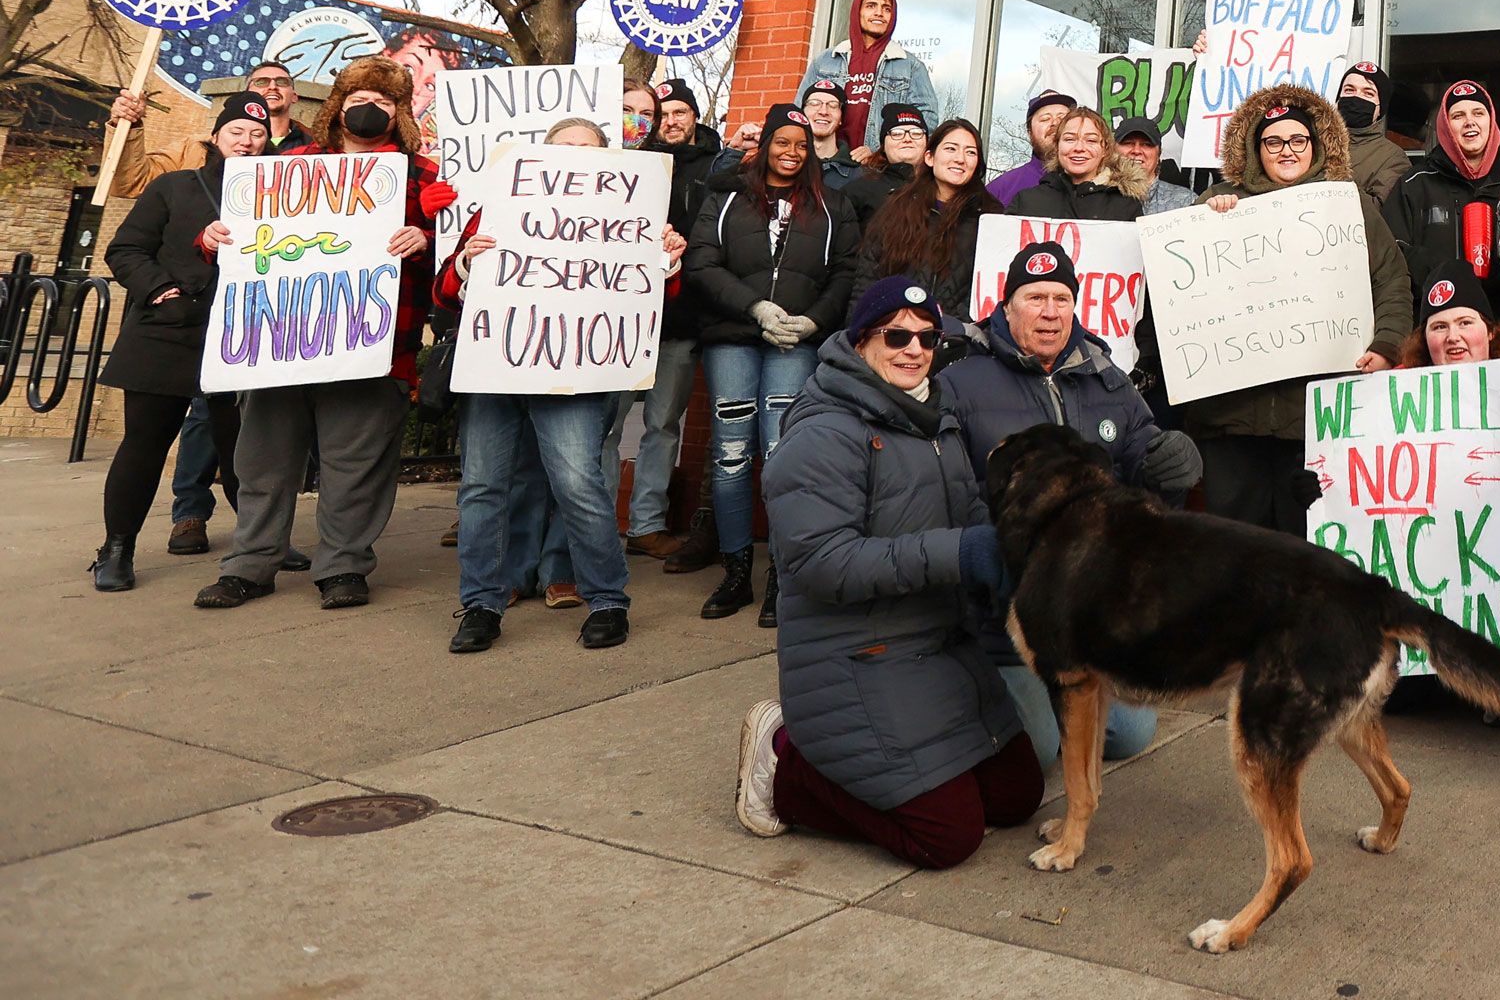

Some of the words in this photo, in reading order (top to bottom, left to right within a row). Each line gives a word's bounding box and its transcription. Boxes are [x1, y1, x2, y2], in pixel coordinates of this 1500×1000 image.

[290, 14, 349, 33] ELMWOOD
[1227, 29, 1259, 68] IS
[1268, 34, 1295, 74] A
[446, 66, 600, 126] UNION
[254, 157, 379, 220] HONK
[511, 158, 640, 204] EVERY
[520, 207, 654, 244] WORKER
[1221, 206, 1258, 222] FOOLED
[241, 224, 352, 275] for
[495, 249, 652, 294] DESERVES
[1164, 228, 1283, 290] SIREN
[1299, 211, 1367, 257] SONG
[221, 264, 398, 366] UNIONS
[976, 271, 1146, 339] WERS
[1336, 291, 1345, 299] IS
[473, 309, 491, 342] A
[502, 304, 657, 371] UNION!
[1176, 318, 1361, 380] DISGUSTING
[1314, 379, 1365, 442] WE
[1348, 441, 1455, 507] NOT
